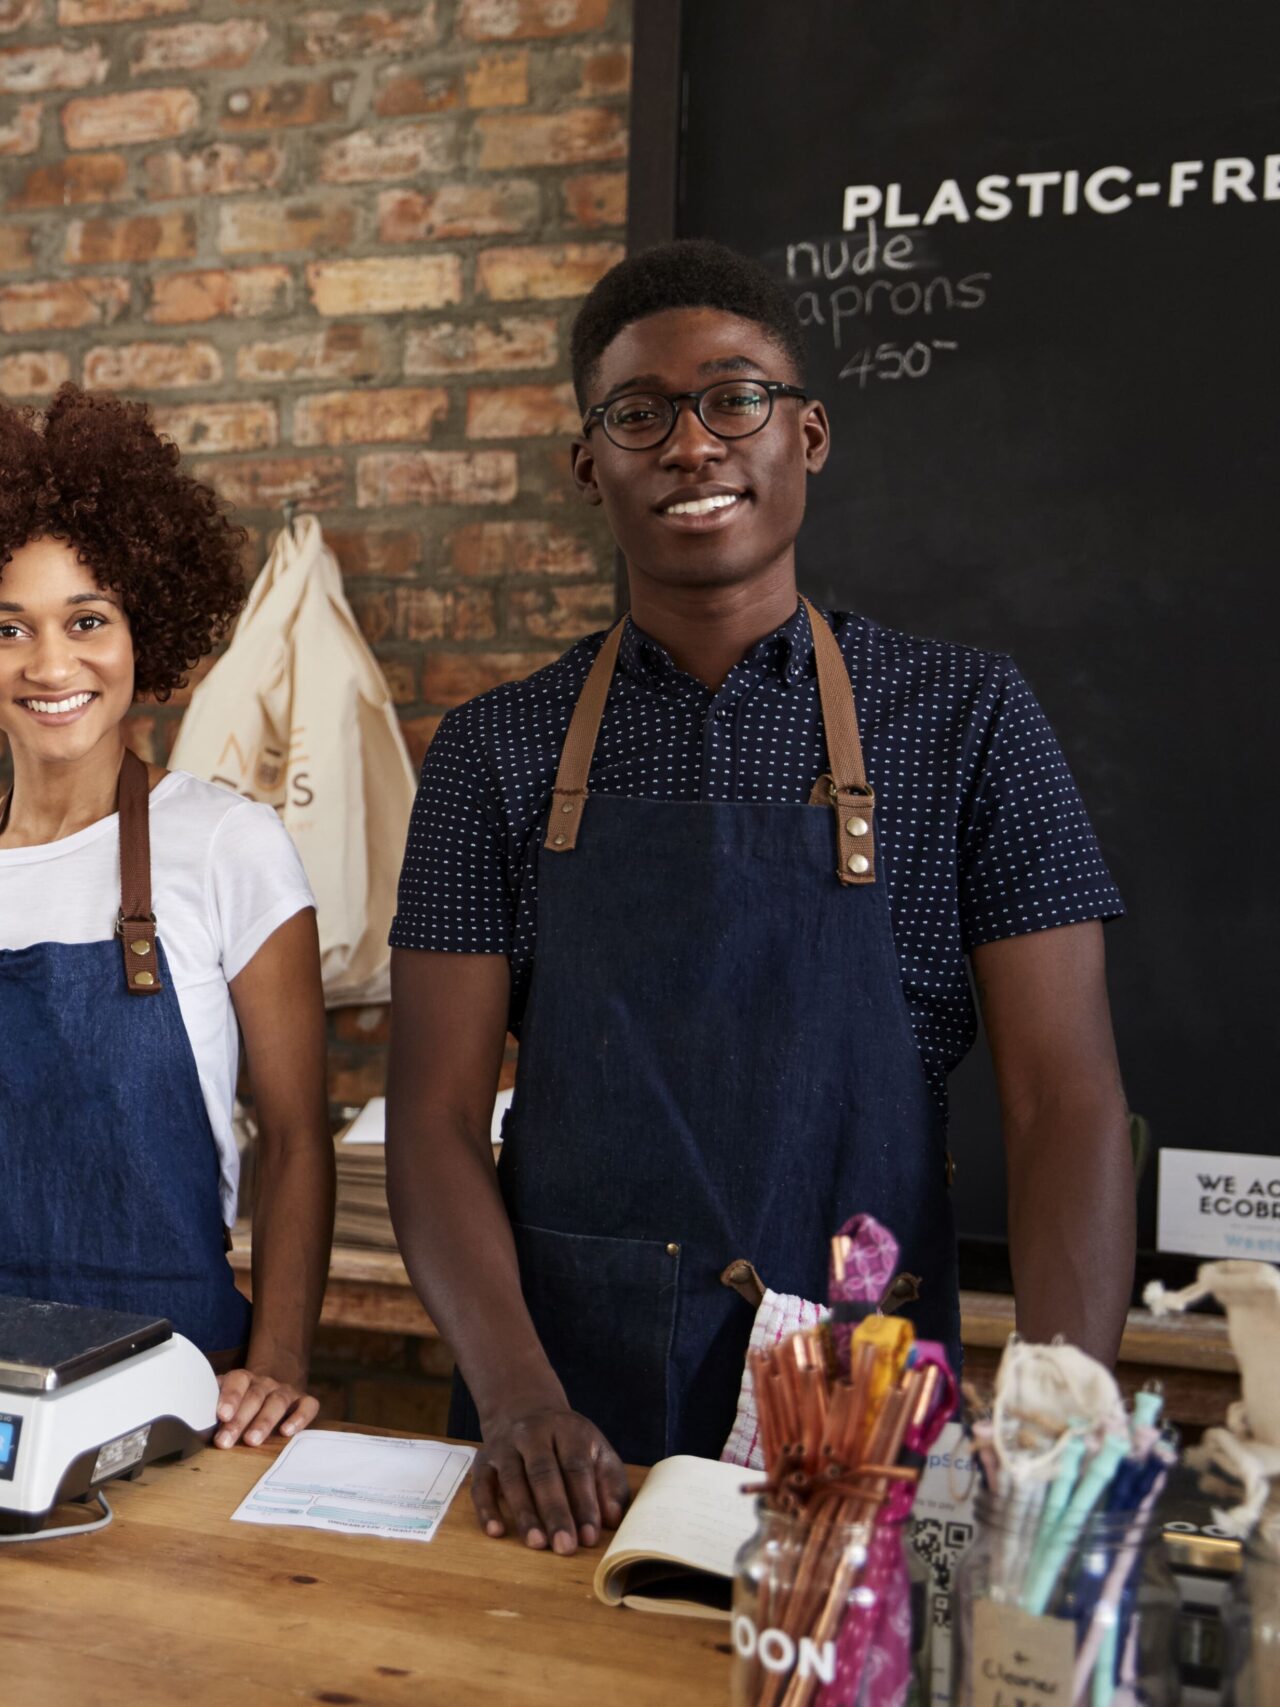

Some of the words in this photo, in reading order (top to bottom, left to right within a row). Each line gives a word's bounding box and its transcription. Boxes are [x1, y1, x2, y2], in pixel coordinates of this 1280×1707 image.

[786, 218, 916, 280] nude
[793, 272, 992, 349] aprons
[1196, 1173, 1236, 1195] WE
